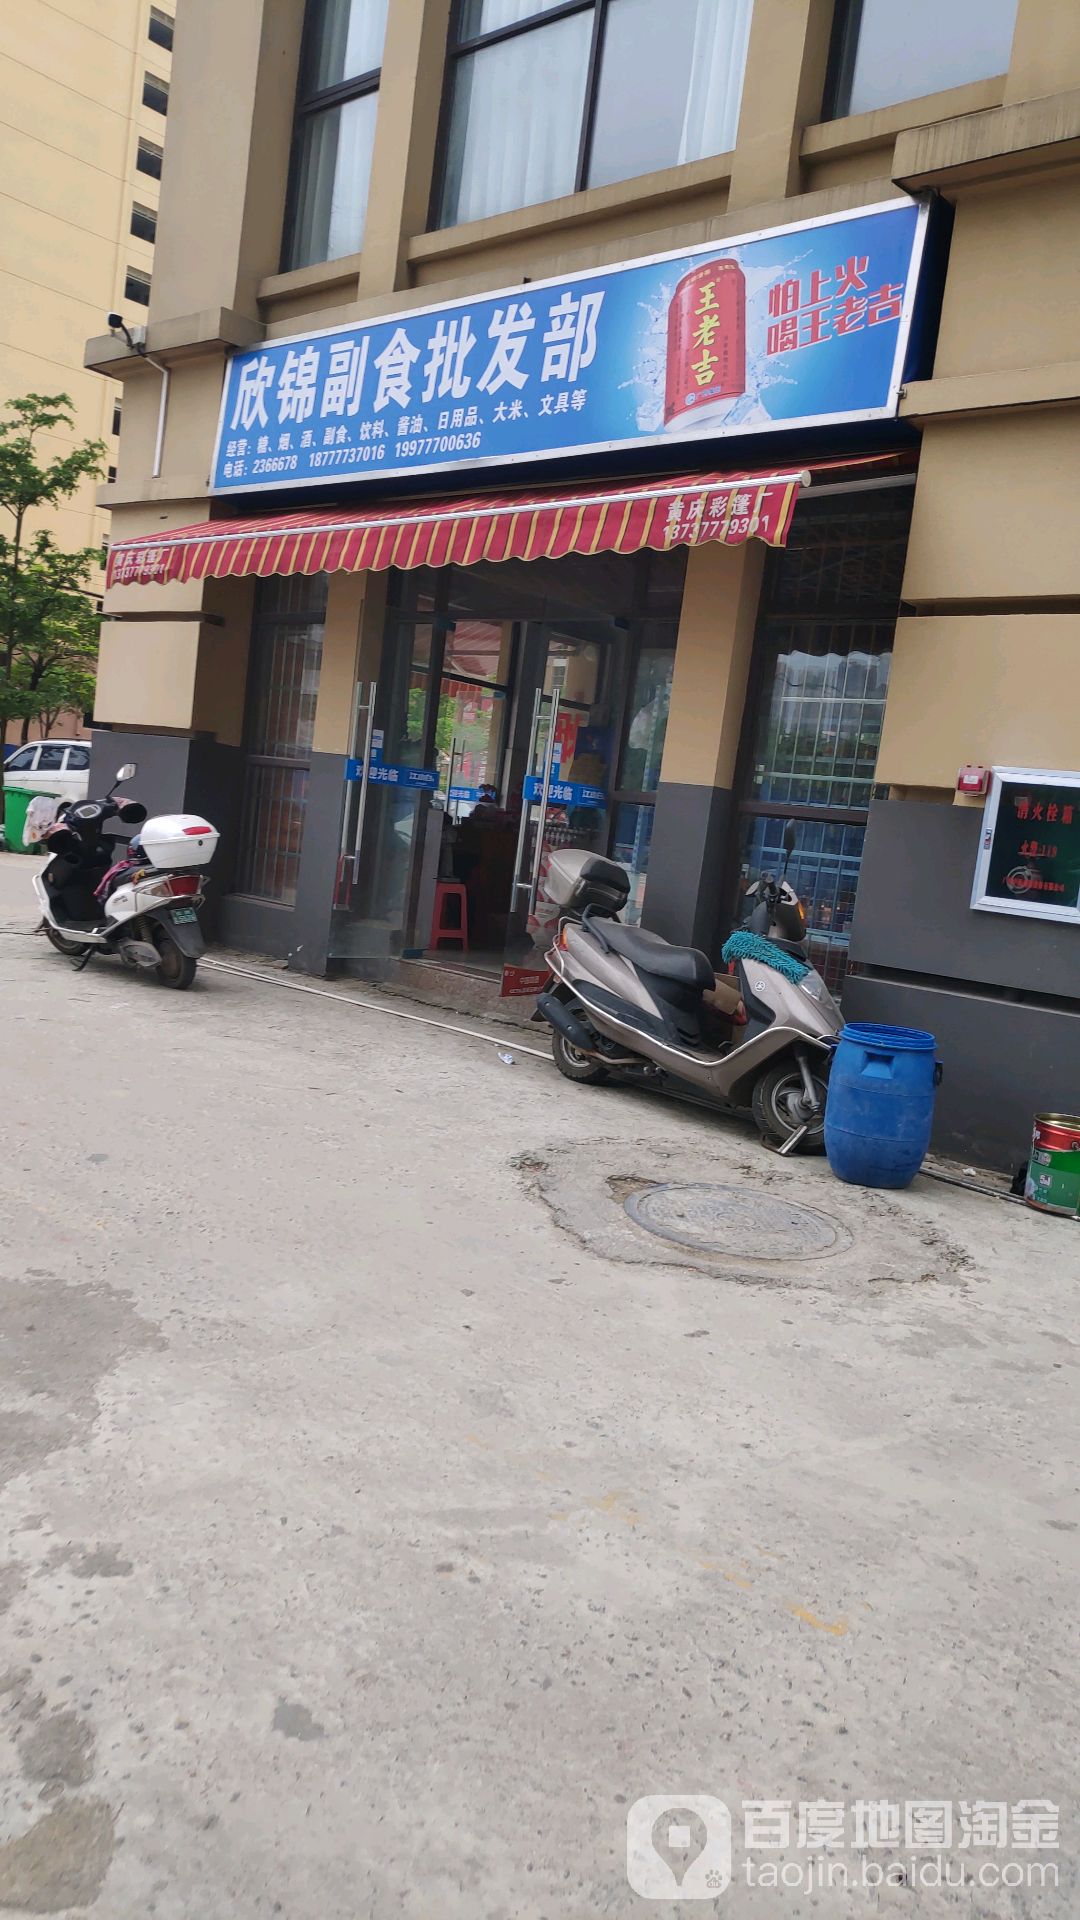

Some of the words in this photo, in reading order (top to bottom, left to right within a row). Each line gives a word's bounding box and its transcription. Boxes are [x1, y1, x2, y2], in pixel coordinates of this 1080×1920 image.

[766, 282, 904, 356] 喝王老吉
[768, 255, 869, 317] 怕上火
[229, 291, 606, 431] 欣锦副食批发部
[690, 281, 720, 386] 王老吉
[309, 444, 385, 467] 18777737016
[395, 431, 481, 458] 19977700636
